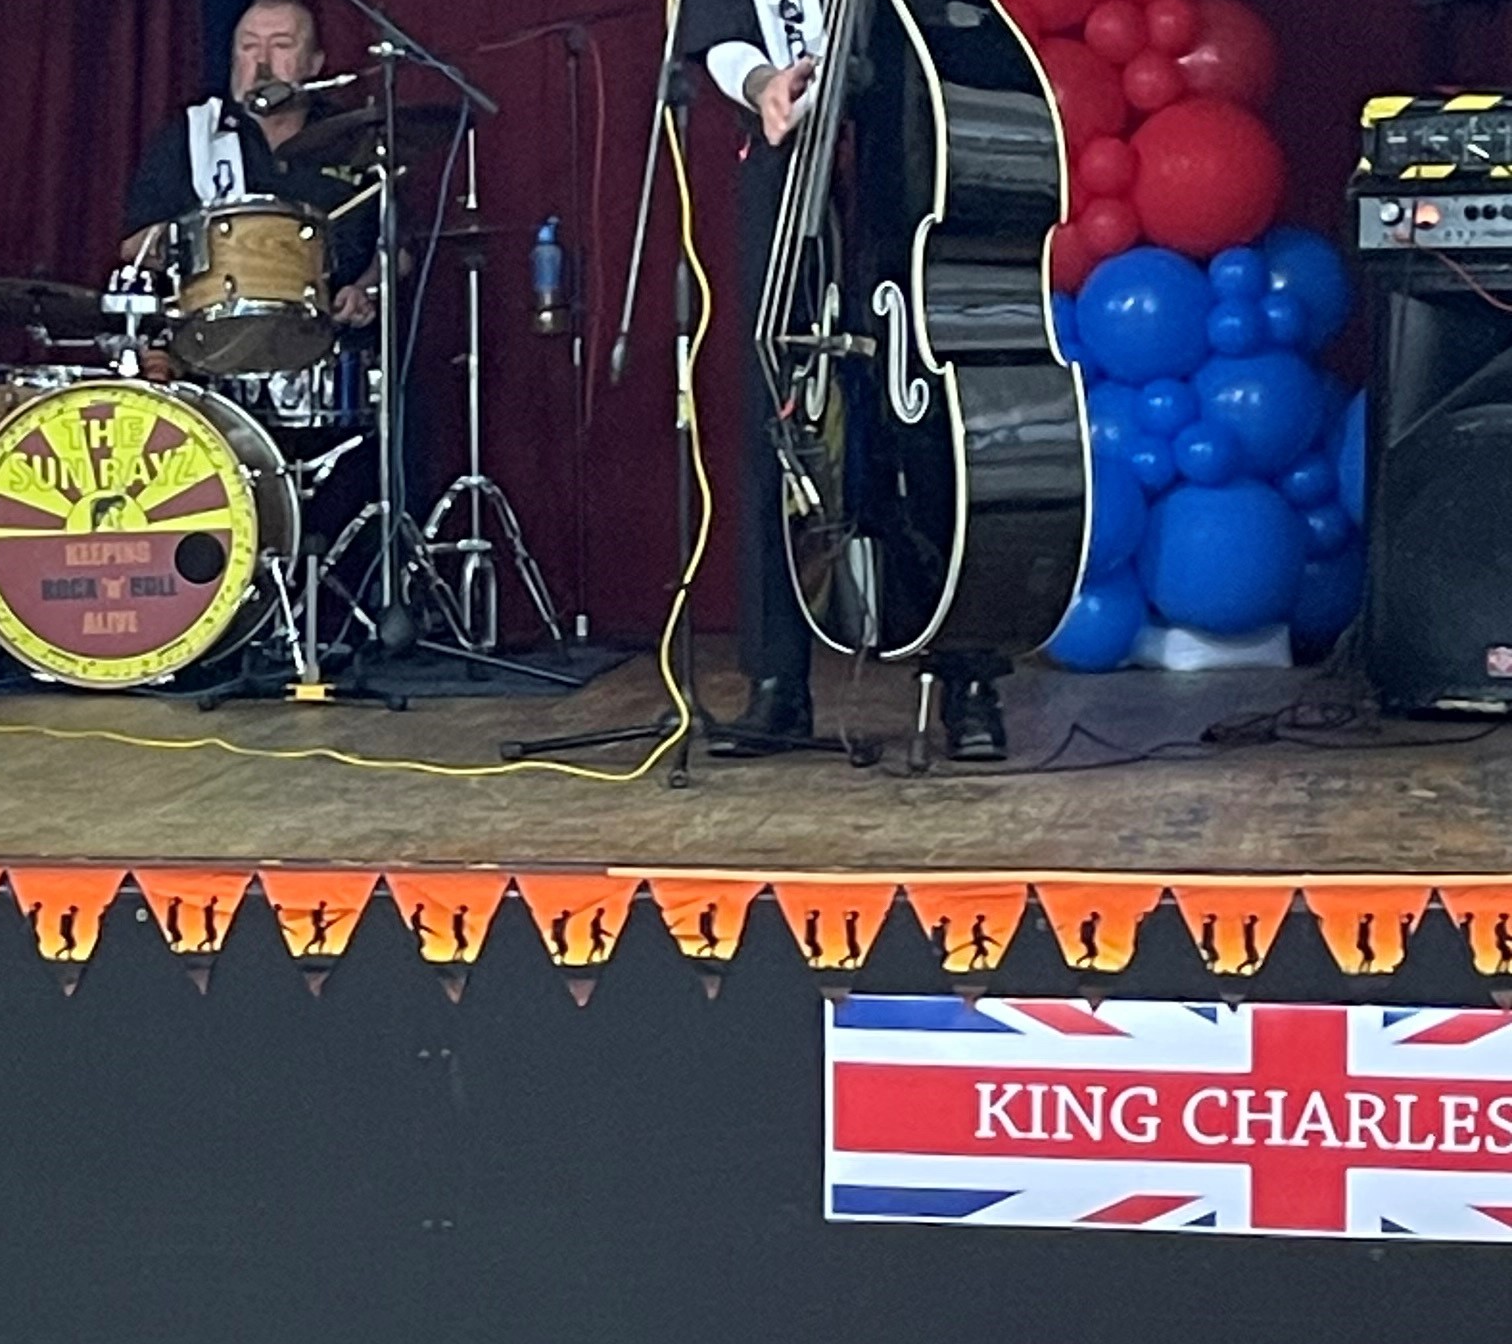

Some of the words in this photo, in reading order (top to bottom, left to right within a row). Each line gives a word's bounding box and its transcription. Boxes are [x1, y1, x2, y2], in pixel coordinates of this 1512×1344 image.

[62, 416, 144, 450] THE
[9, 452, 89, 492] SUN
[99, 437, 199, 489] RAYZ
[65, 540, 151, 567] KEEPING
[83, 610, 138, 635] ALIVE
[974, 1082, 1160, 1144] KING
[1182, 1088, 1512, 1154] CHARLES
